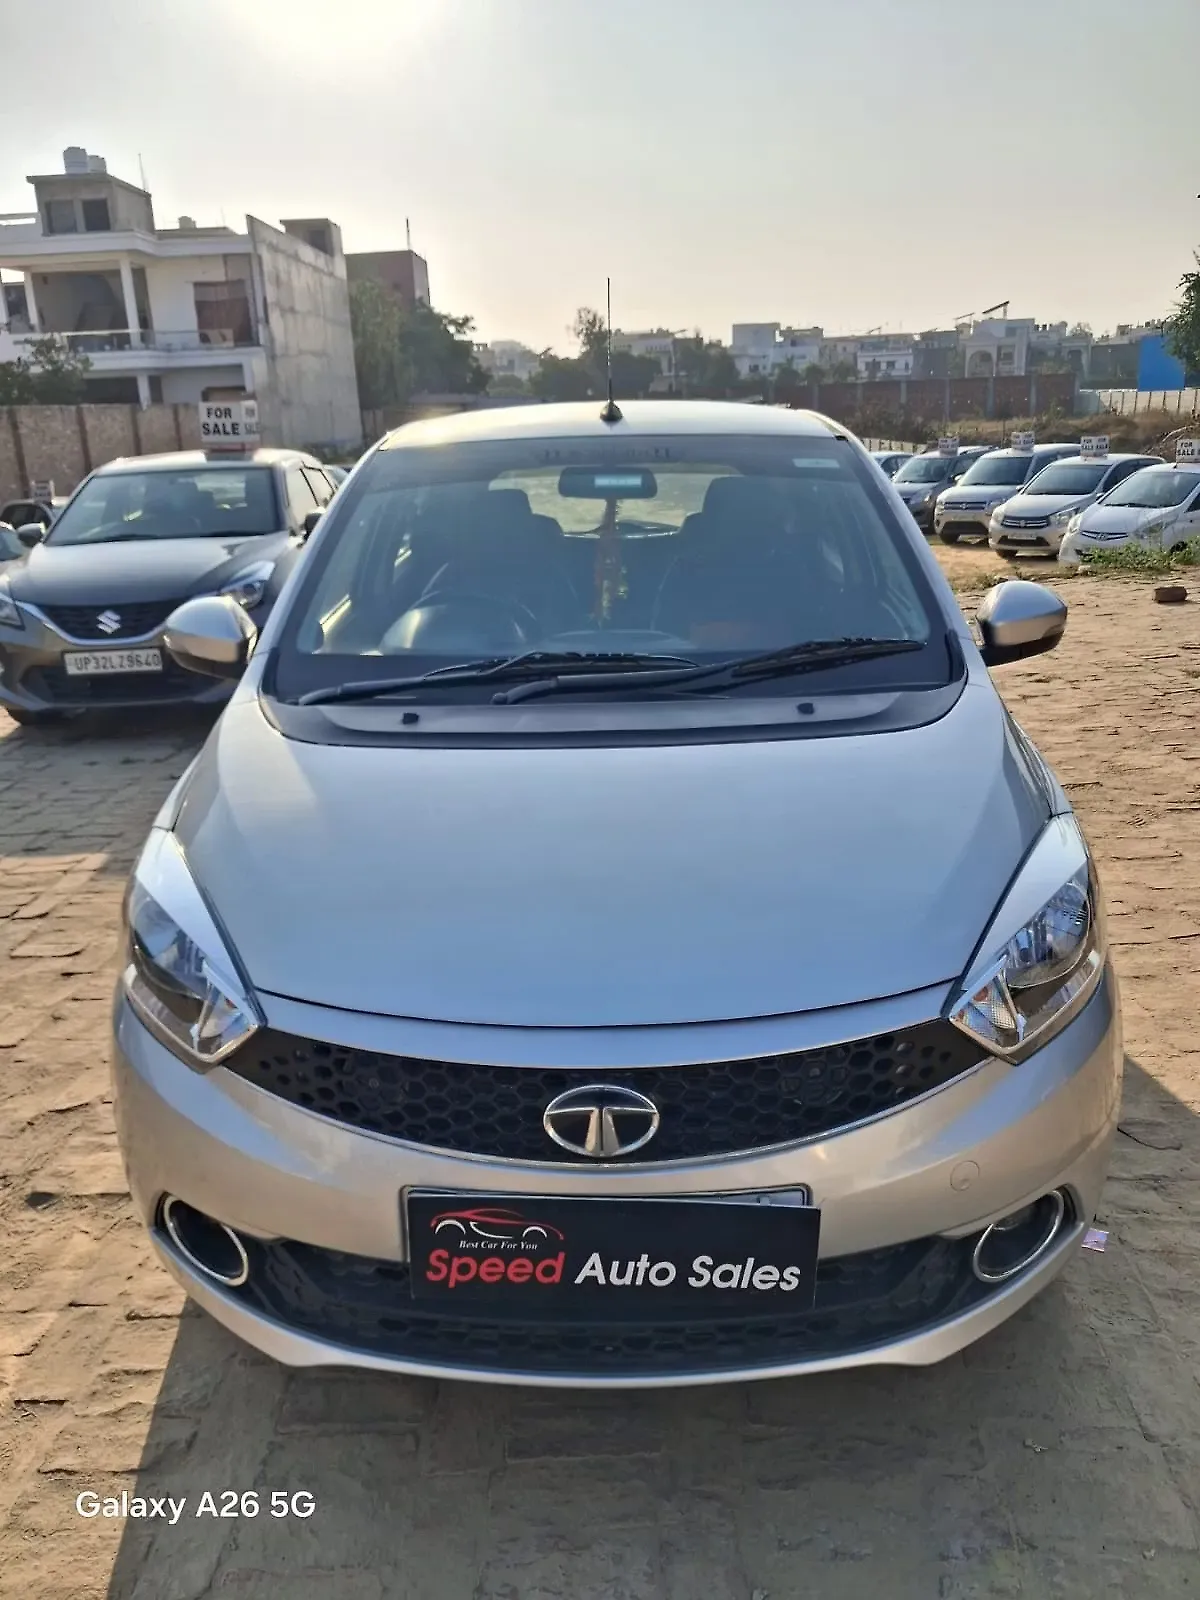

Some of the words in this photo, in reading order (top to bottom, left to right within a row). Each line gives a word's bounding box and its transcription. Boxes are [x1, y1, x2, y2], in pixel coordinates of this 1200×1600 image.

[206, 407, 232, 419] FOR
[202, 422, 240, 436] SALE
[459, 1240, 479, 1249] Best
[480, 1240, 498, 1249] Car
[501, 1241, 518, 1249] For
[520, 1241, 538, 1250] You
[426, 1248, 566, 1289] Speed
[574, 1252, 677, 1287] Auto
[687, 1255, 801, 1292] Sales
